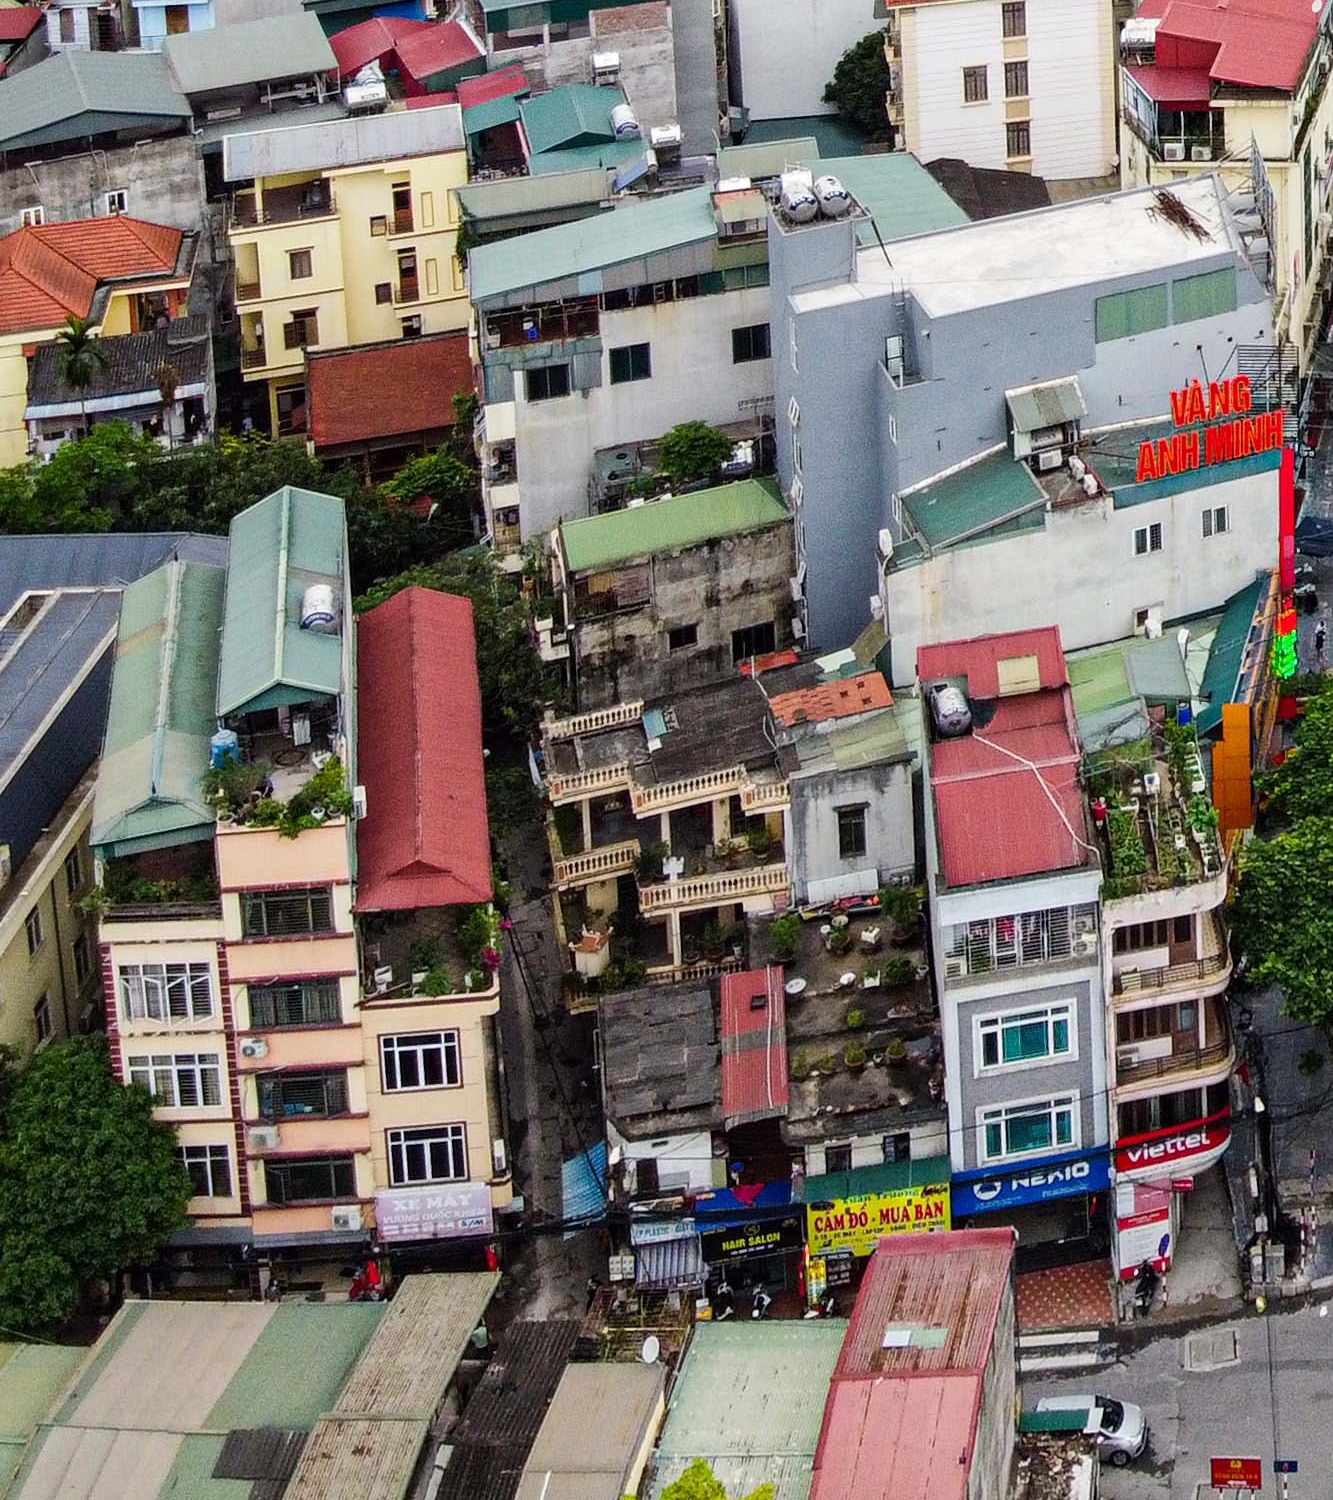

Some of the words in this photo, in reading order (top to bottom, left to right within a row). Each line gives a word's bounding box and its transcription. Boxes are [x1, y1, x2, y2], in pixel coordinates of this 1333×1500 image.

[1170, 375, 1251, 427] VÀNG
[1136, 431, 1199, 482] ANH
[1205, 410, 1284, 465] MINH
[1127, 1129, 1210, 1162] viettel
[879, 1206, 911, 1226] MUA
[721, 1238, 746, 1252] HAIR
[748, 1231, 781, 1247] SALON
